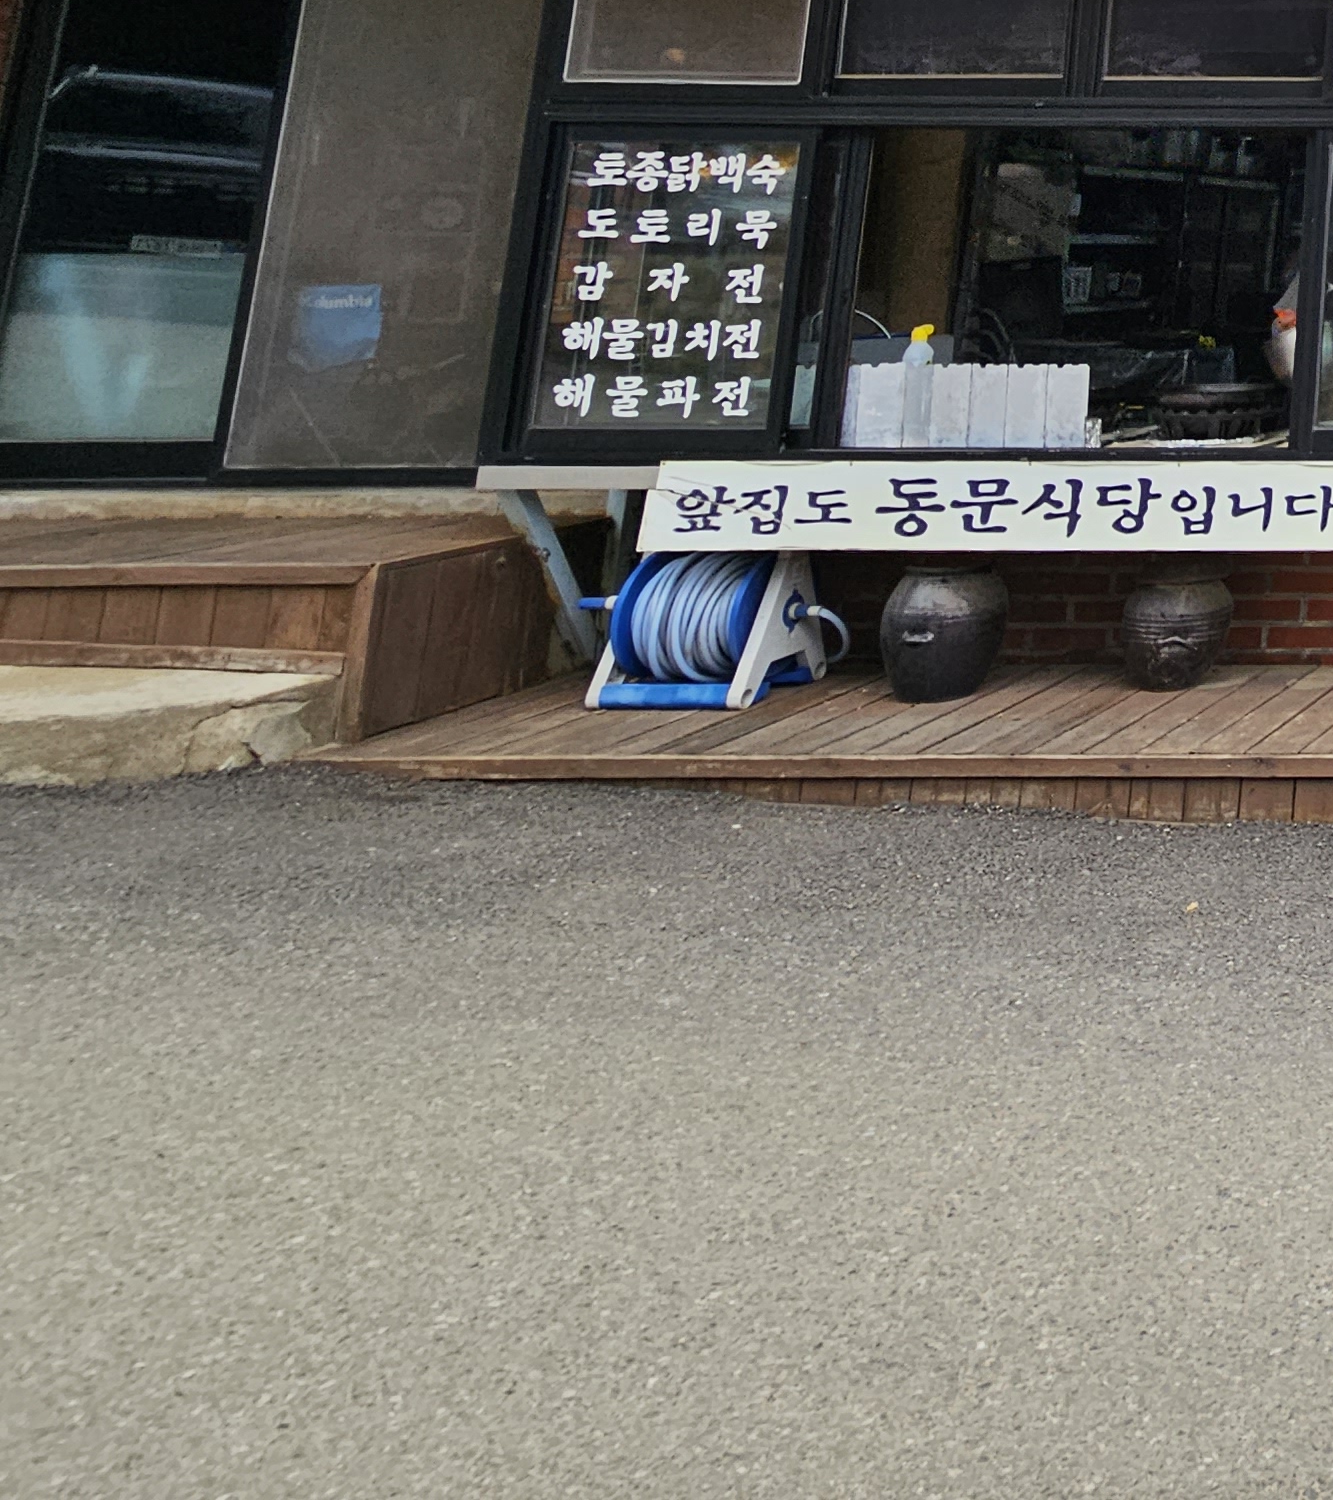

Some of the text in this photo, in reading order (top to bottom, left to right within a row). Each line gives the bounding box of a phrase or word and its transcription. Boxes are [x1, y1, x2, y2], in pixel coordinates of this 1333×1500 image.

[587, 151, 786, 194] 토종닭백숙
[577, 208, 777, 249] 도토리묵
[573, 262, 765, 304] 감자전
[562, 317, 762, 360] 해물김치전
[552, 373, 752, 418] 해물파전
[672, 484, 853, 536] 앞집도
